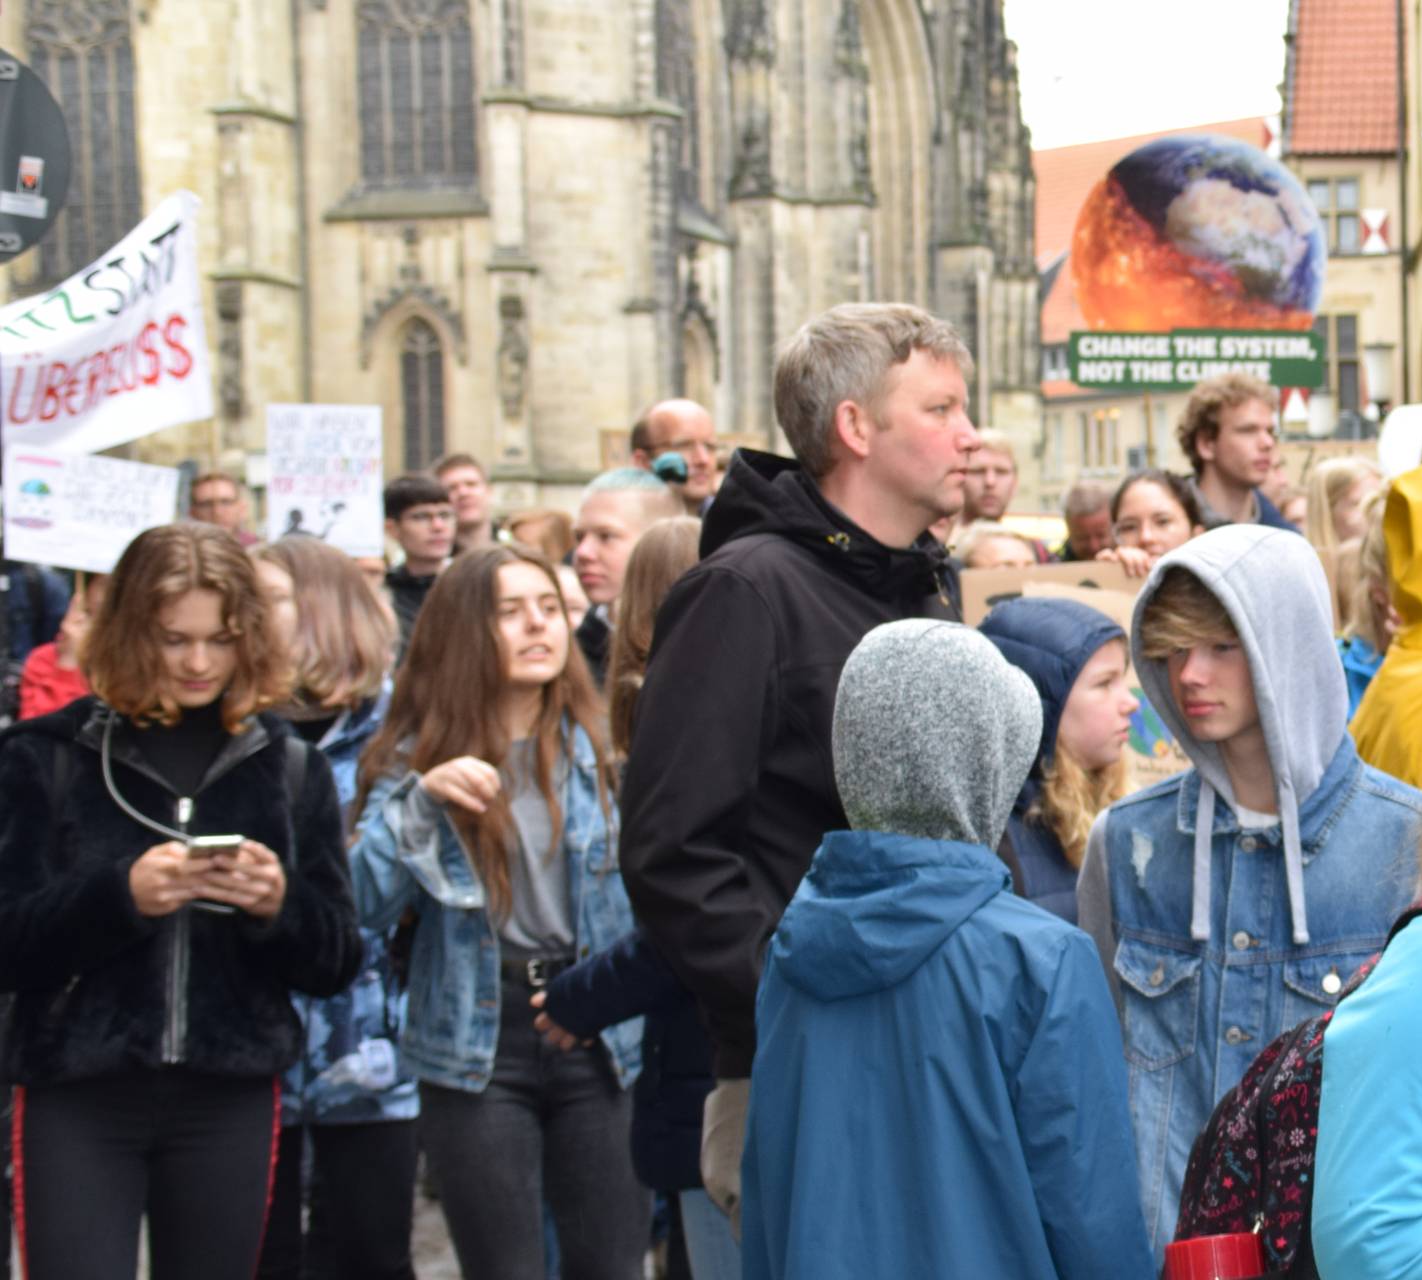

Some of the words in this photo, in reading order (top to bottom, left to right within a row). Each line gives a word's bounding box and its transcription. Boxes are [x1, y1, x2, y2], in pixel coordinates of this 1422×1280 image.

[1078, 337, 1169, 358] CHANGE
[1174, 336, 1217, 357] THE
[1220, 336, 1317, 361] SYSTEM,
[1078, 361, 1126, 382] NOT
[1129, 361, 1172, 382] THE
[1176, 360, 1272, 382] CLIMATE
